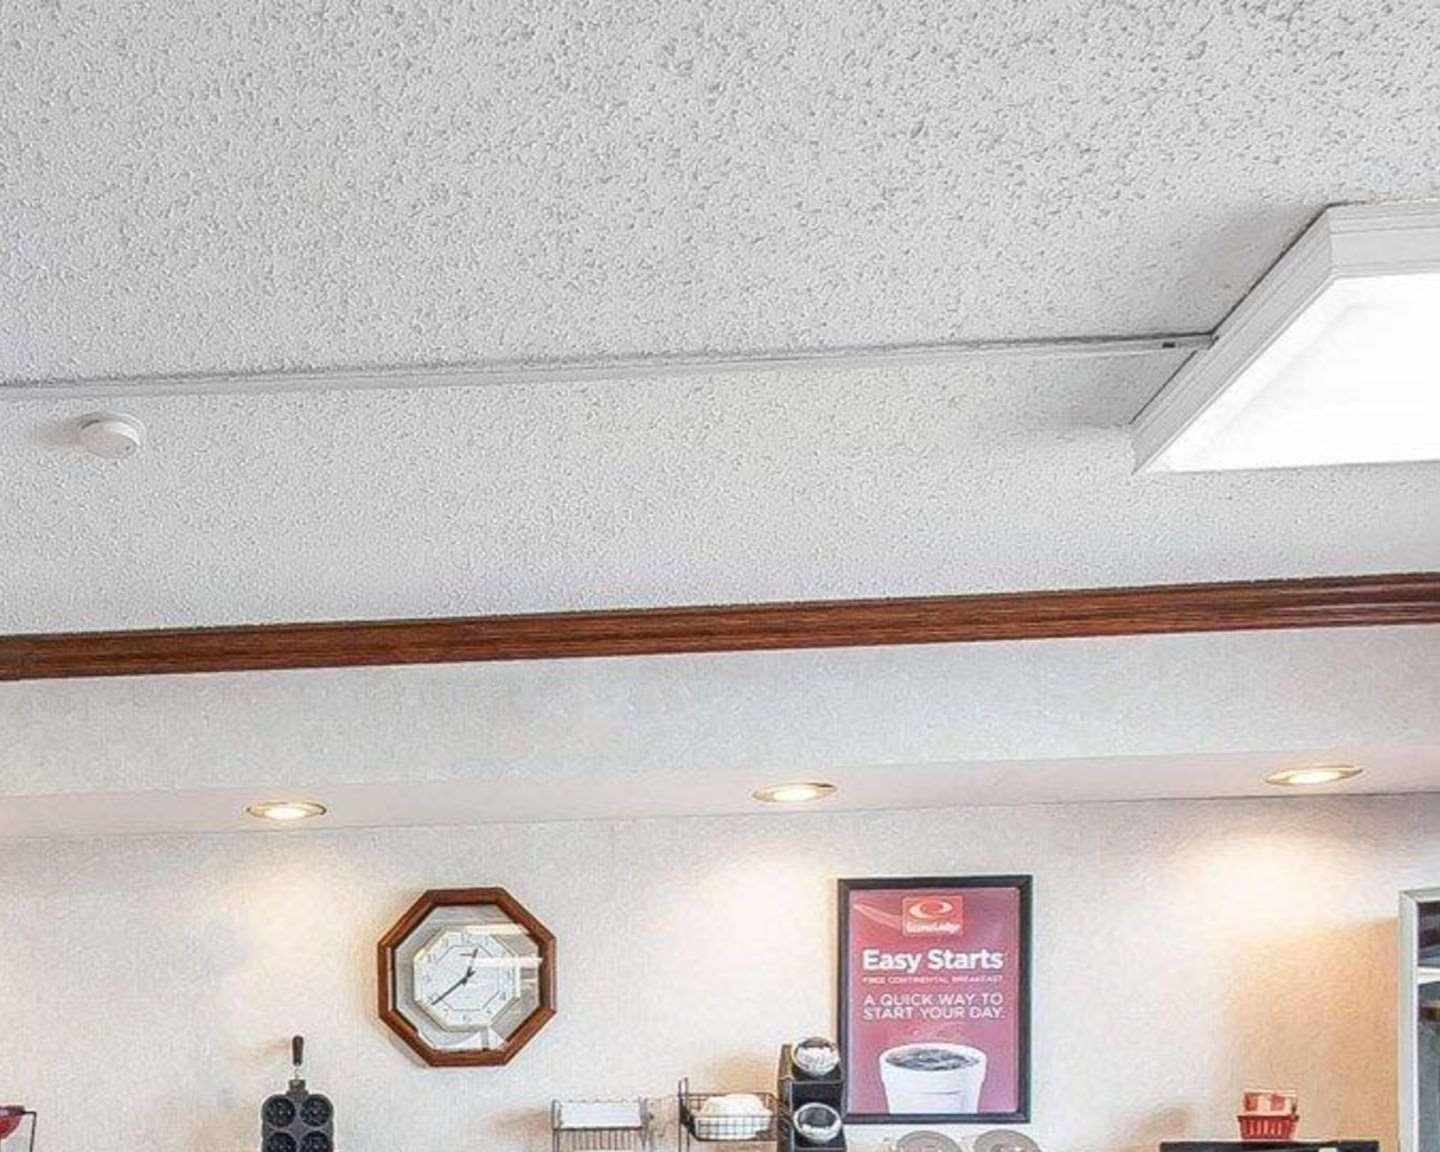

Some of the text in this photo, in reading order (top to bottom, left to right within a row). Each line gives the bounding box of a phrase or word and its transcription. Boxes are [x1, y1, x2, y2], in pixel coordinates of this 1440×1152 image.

[862, 948, 1004, 974] Easy Starts
[863, 993, 1005, 1006] A QUICK WAY TO
[863, 1006, 1006, 1020] START YOUR DAY.
